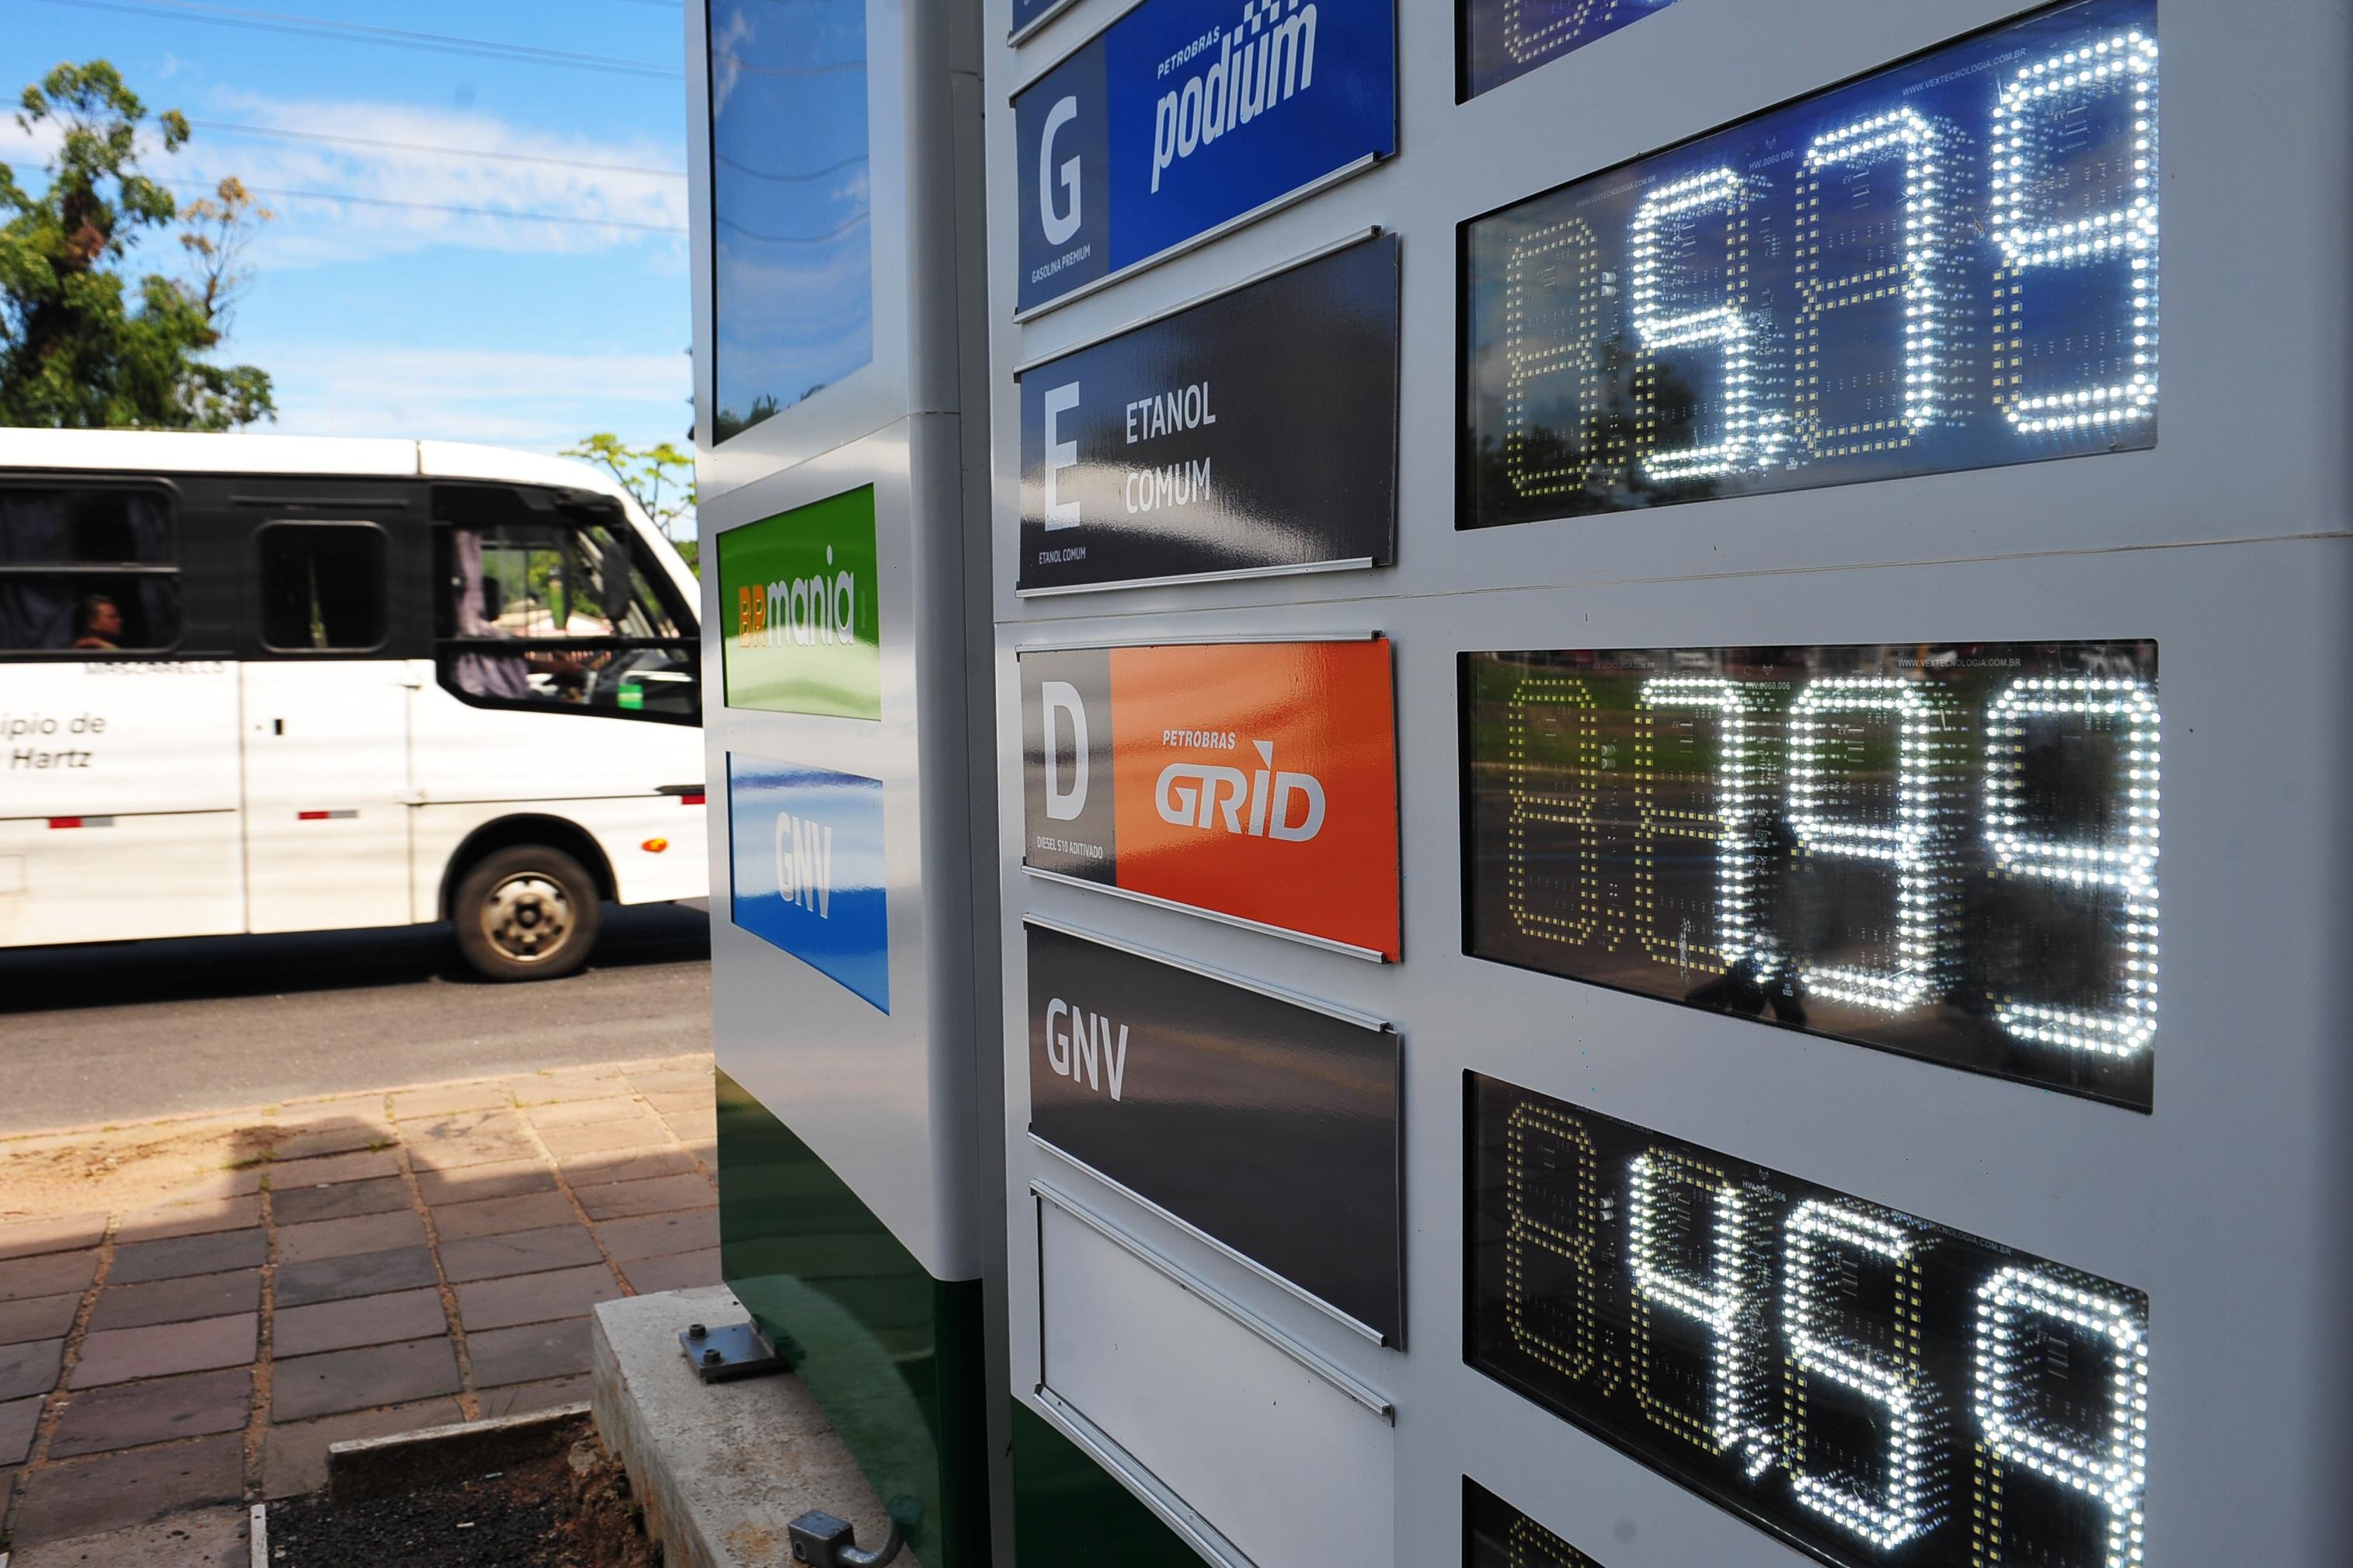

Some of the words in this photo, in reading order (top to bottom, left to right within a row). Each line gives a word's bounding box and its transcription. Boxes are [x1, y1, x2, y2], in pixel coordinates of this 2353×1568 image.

[1157, 25, 1220, 80] PETROBRAS
[1902, 47, 2027, 96] WWW.VEXTECNOLOGIA.COM.BR
[1150, 3, 1317, 195] podium
[1039, 95, 1081, 245] G
[1749, 149, 1794, 171] HW.0060.006
[1031, 258, 1062, 283] GASOLINA
[1061, 242, 1091, 269] PREMIUM
[1126, 381, 1217, 444] ETANOL
[1045, 381, 1081, 532] E
[1126, 457, 1211, 514] COMUM
[1039, 550, 1062, 565] ETANOL
[1062, 546, 1086, 562] COMUM
[1898, 659, 2021, 668] WWW.VEXTECNOLOGIA.COM.BR
[70, 712, 106, 734] de
[1162, 729, 1237, 751] PETROBRAS
[11, 747, 92, 769] Hartz
[1042, 680, 1090, 822] D
[1154, 740, 1326, 843] GRID
[775, 810, 833, 920] GNV
[1036, 836, 1057, 851] DIESEL
[1057, 839, 1069, 854] S10
[1069, 841, 1103, 860] ADITIVADO
[1046, 997, 1129, 1102] GNV
